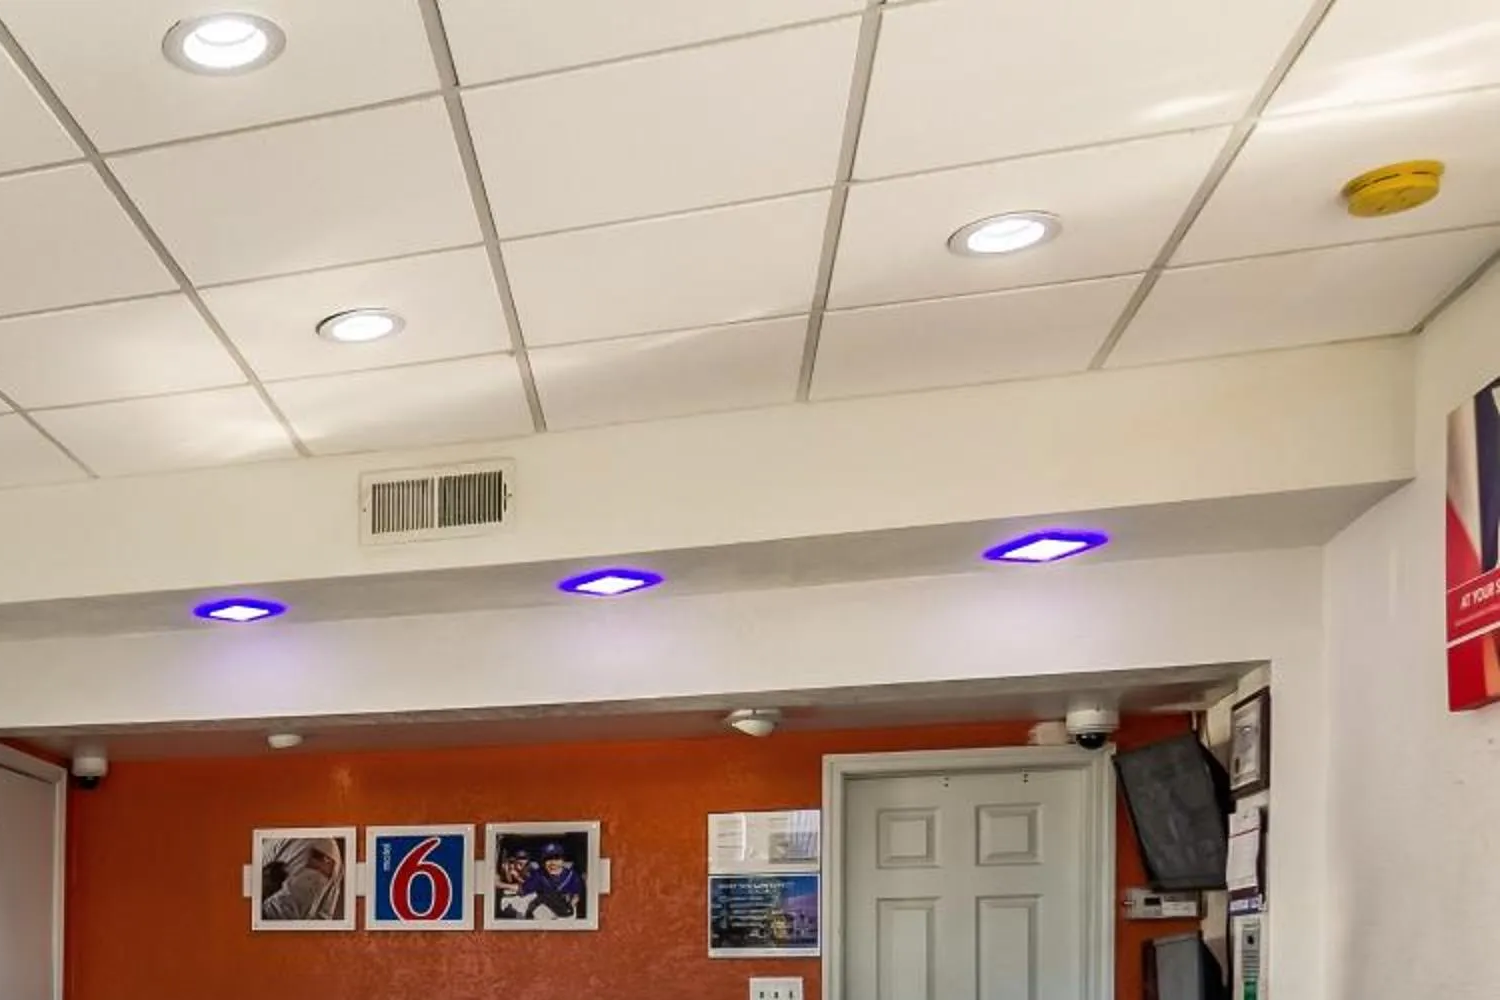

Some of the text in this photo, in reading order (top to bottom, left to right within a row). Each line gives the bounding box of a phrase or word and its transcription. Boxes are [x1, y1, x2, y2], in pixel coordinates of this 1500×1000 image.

[1460, 592, 1471, 610] AT
[1472, 581, 1495, 605] YOUR
[382, 837, 453, 921] motel 6
